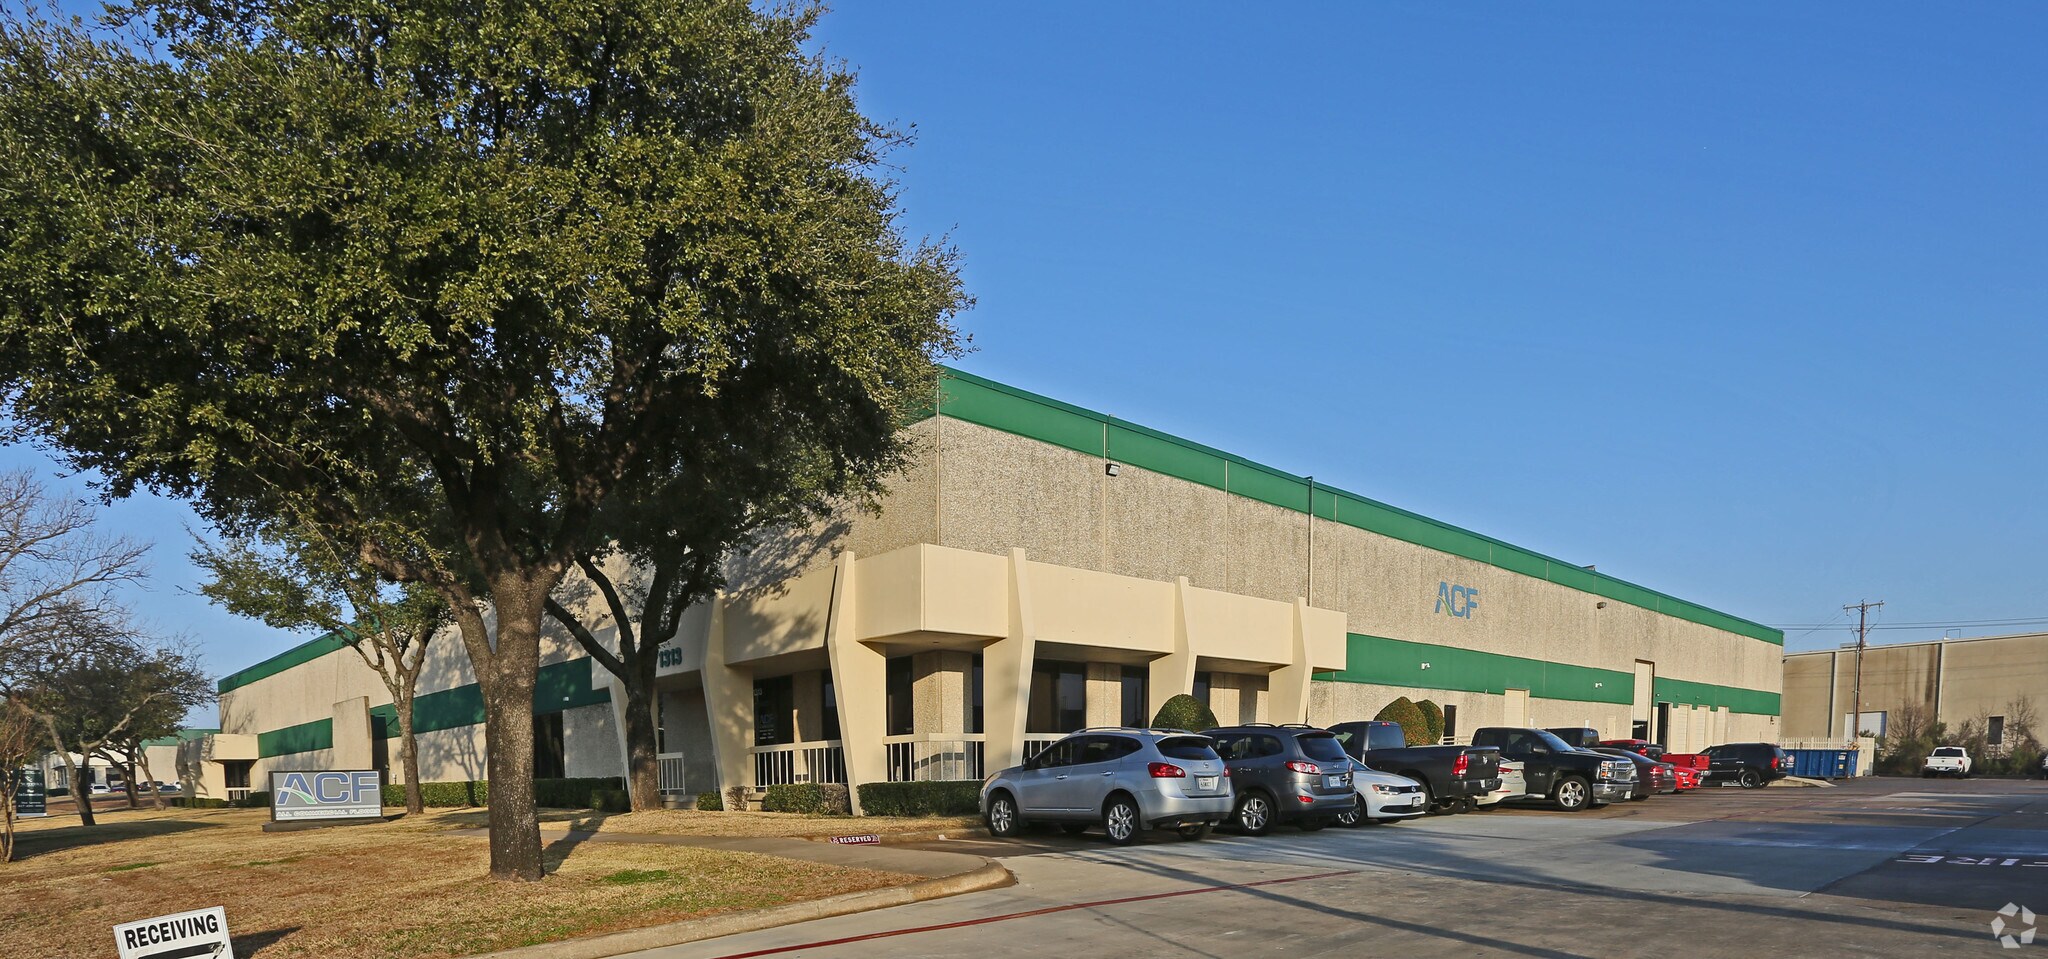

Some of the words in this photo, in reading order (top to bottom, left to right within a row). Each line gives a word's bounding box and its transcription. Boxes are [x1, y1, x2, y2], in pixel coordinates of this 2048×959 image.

[1435, 581, 1478, 619] ACF
[659, 647, 682, 668] 1313
[275, 771, 379, 805] ACF
[839, 835, 872, 844] RESERVED
[124, 914, 219, 950] RECEIVING
